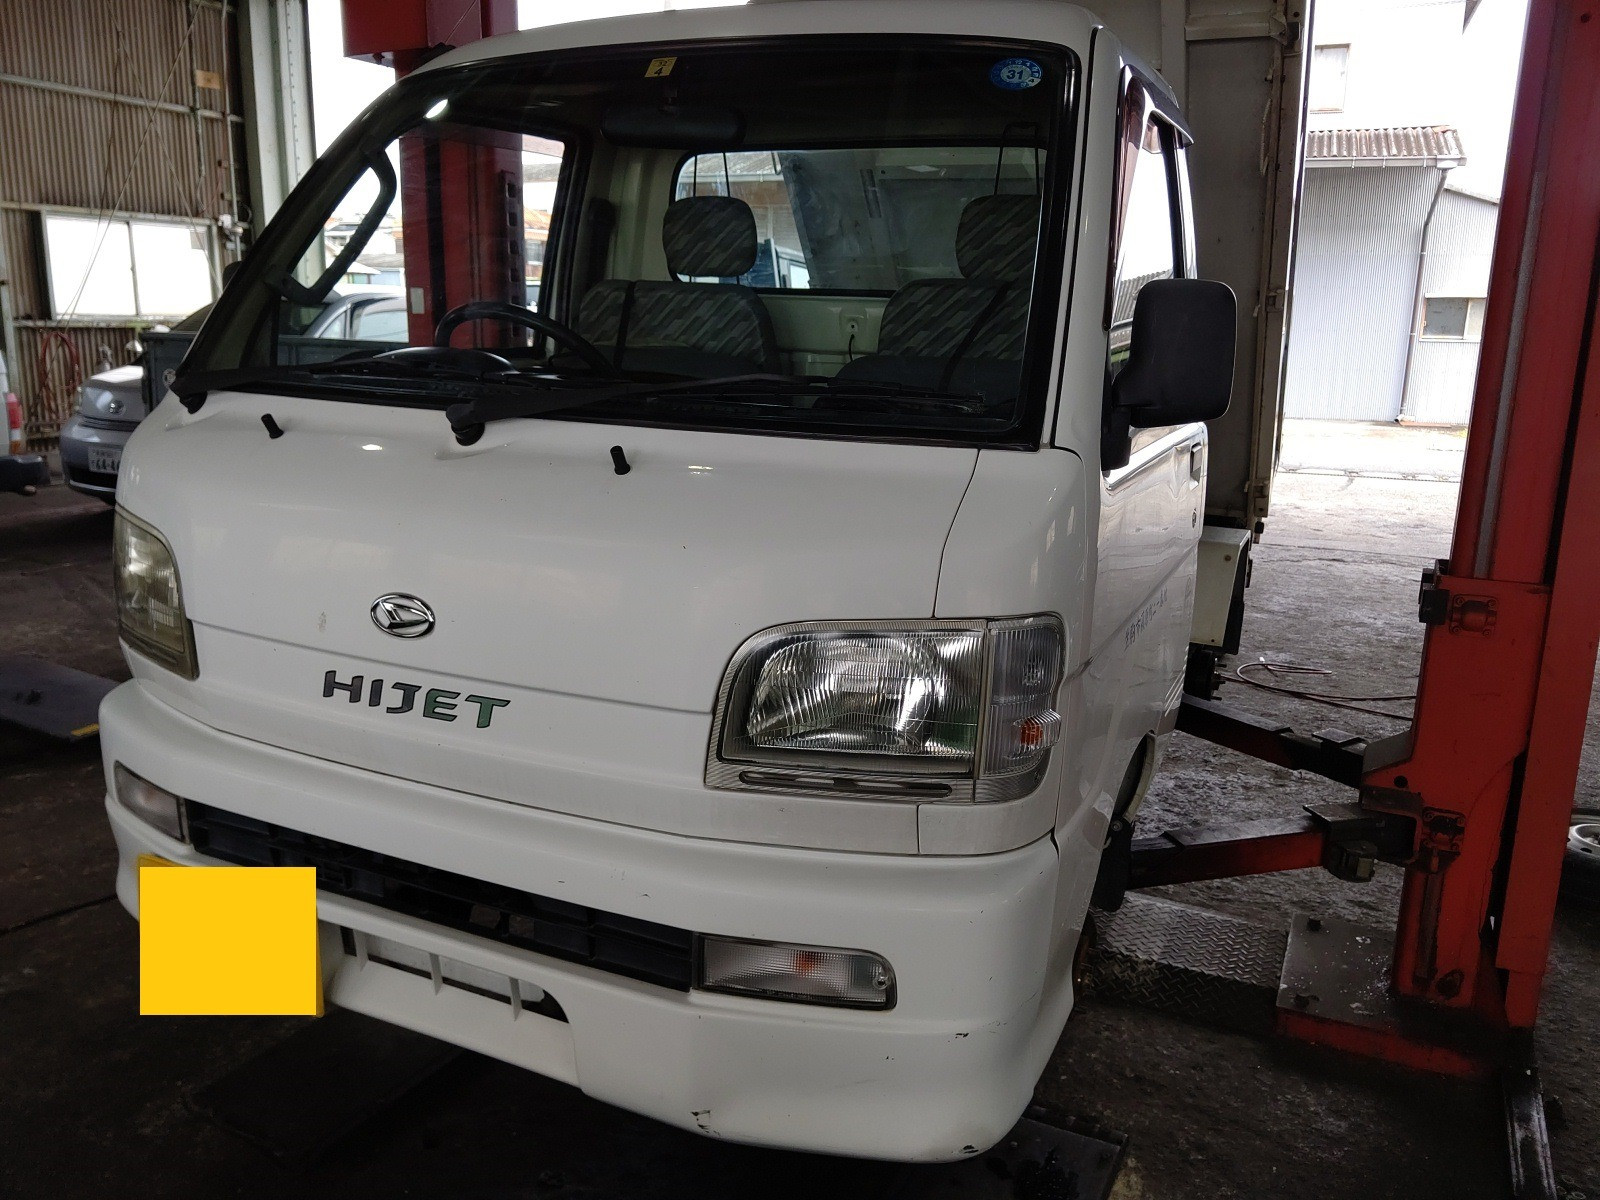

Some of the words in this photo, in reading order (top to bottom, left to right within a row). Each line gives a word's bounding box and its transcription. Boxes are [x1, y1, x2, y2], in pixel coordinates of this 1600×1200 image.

[653, 66, 664, 76] 4
[1006, 69, 1024, 80] 31
[322, 670, 512, 728] HIJET
